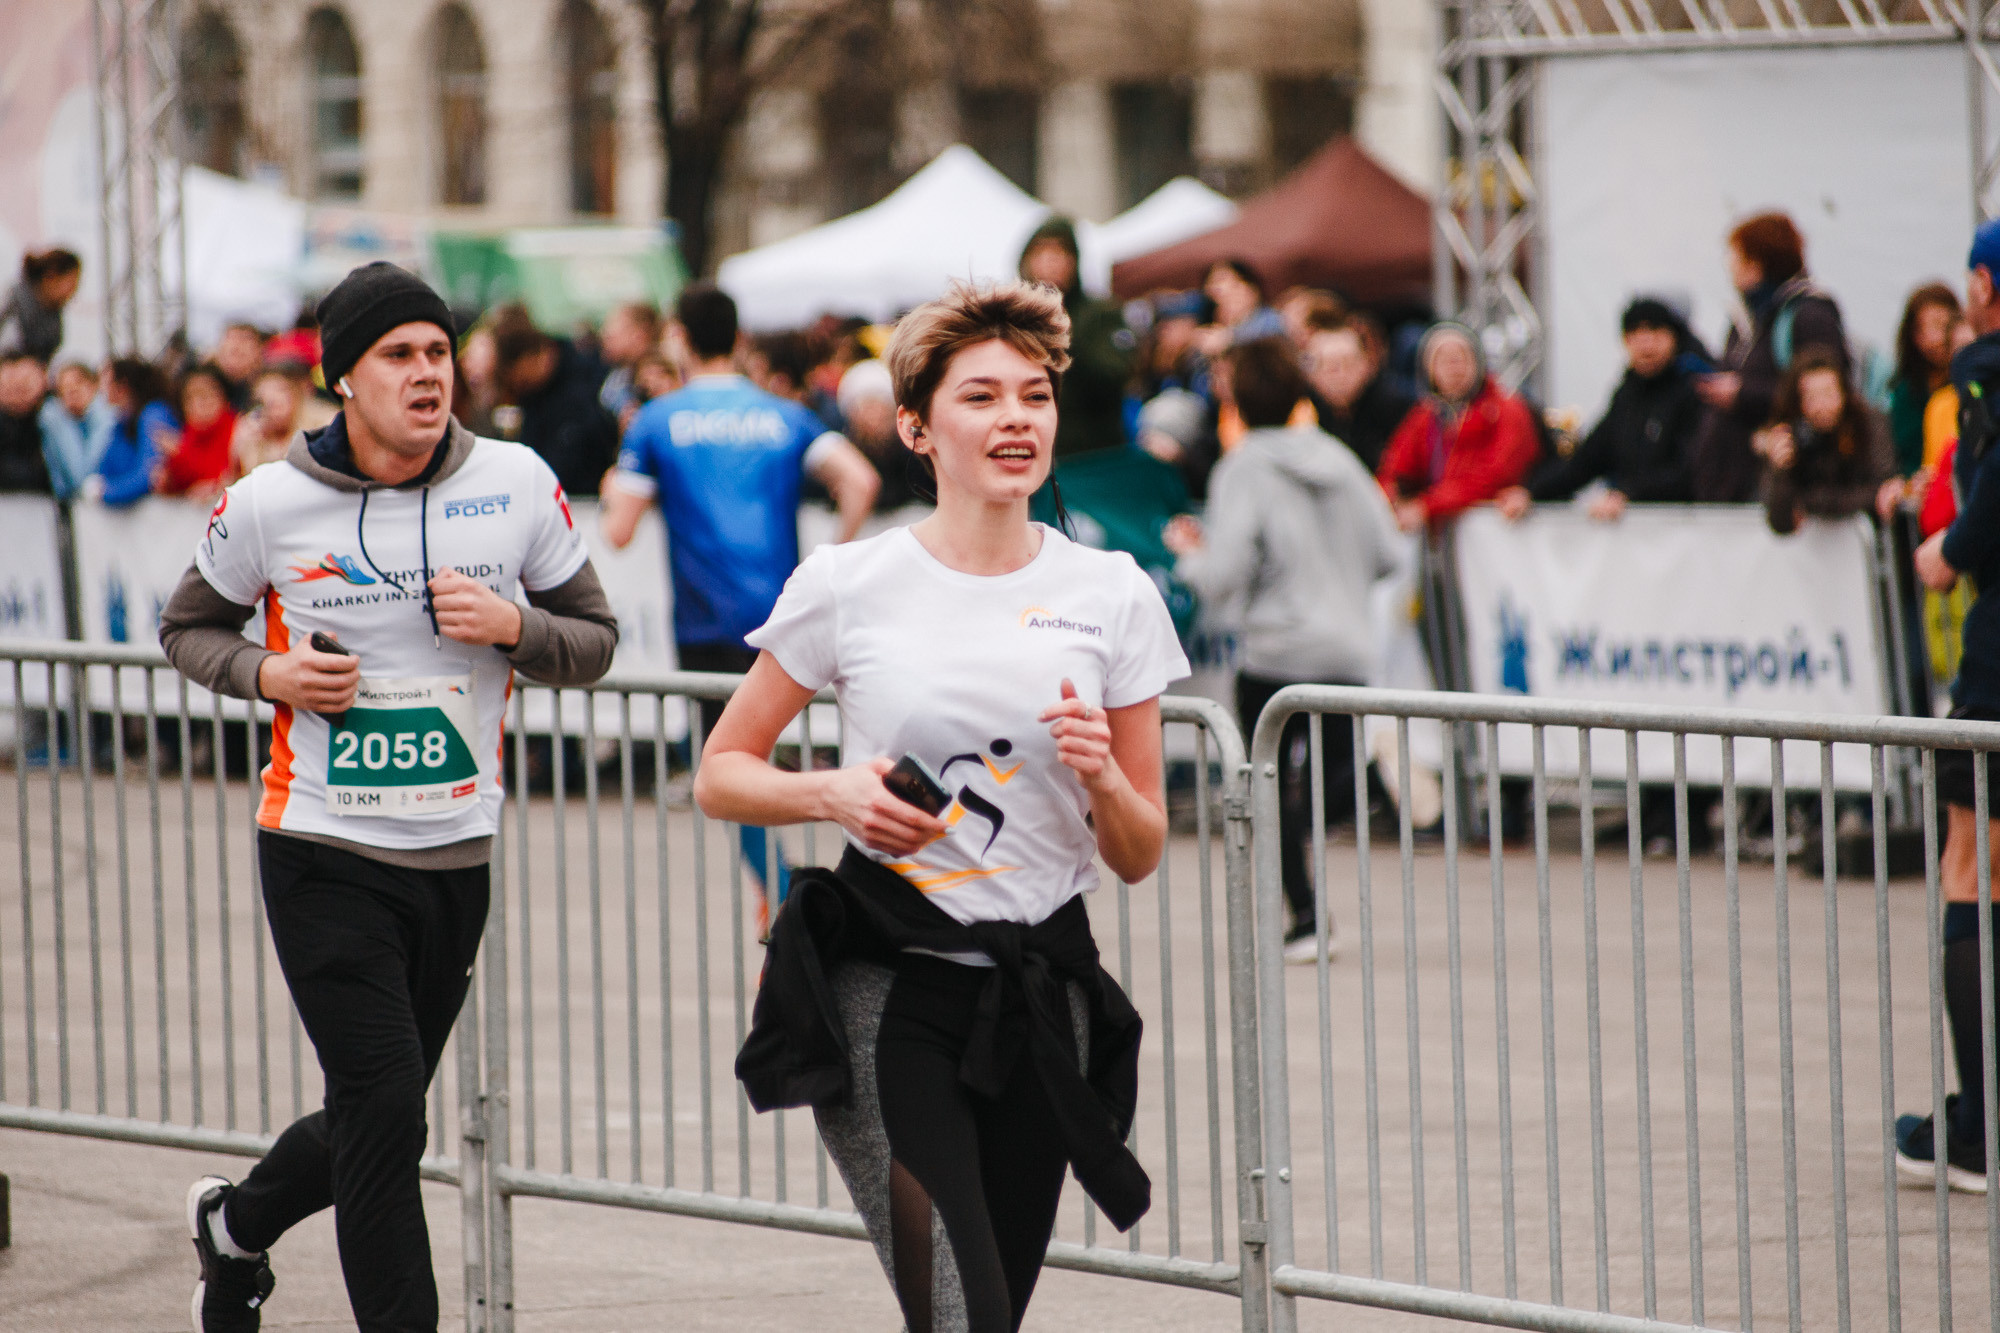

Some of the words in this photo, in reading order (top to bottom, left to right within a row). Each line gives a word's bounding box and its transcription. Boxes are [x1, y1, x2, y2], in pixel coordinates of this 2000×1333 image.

[312, 592, 381, 608] KHARKIV
[1028, 617, 1102, 637] Andersen
[1554, 625, 1853, 700] Жилстрой-1
[357, 689, 431, 701] Жилстрой-1
[333, 730, 447, 770] 2058
[337, 792, 352, 805] 10
[357, 793, 381, 805] KM
